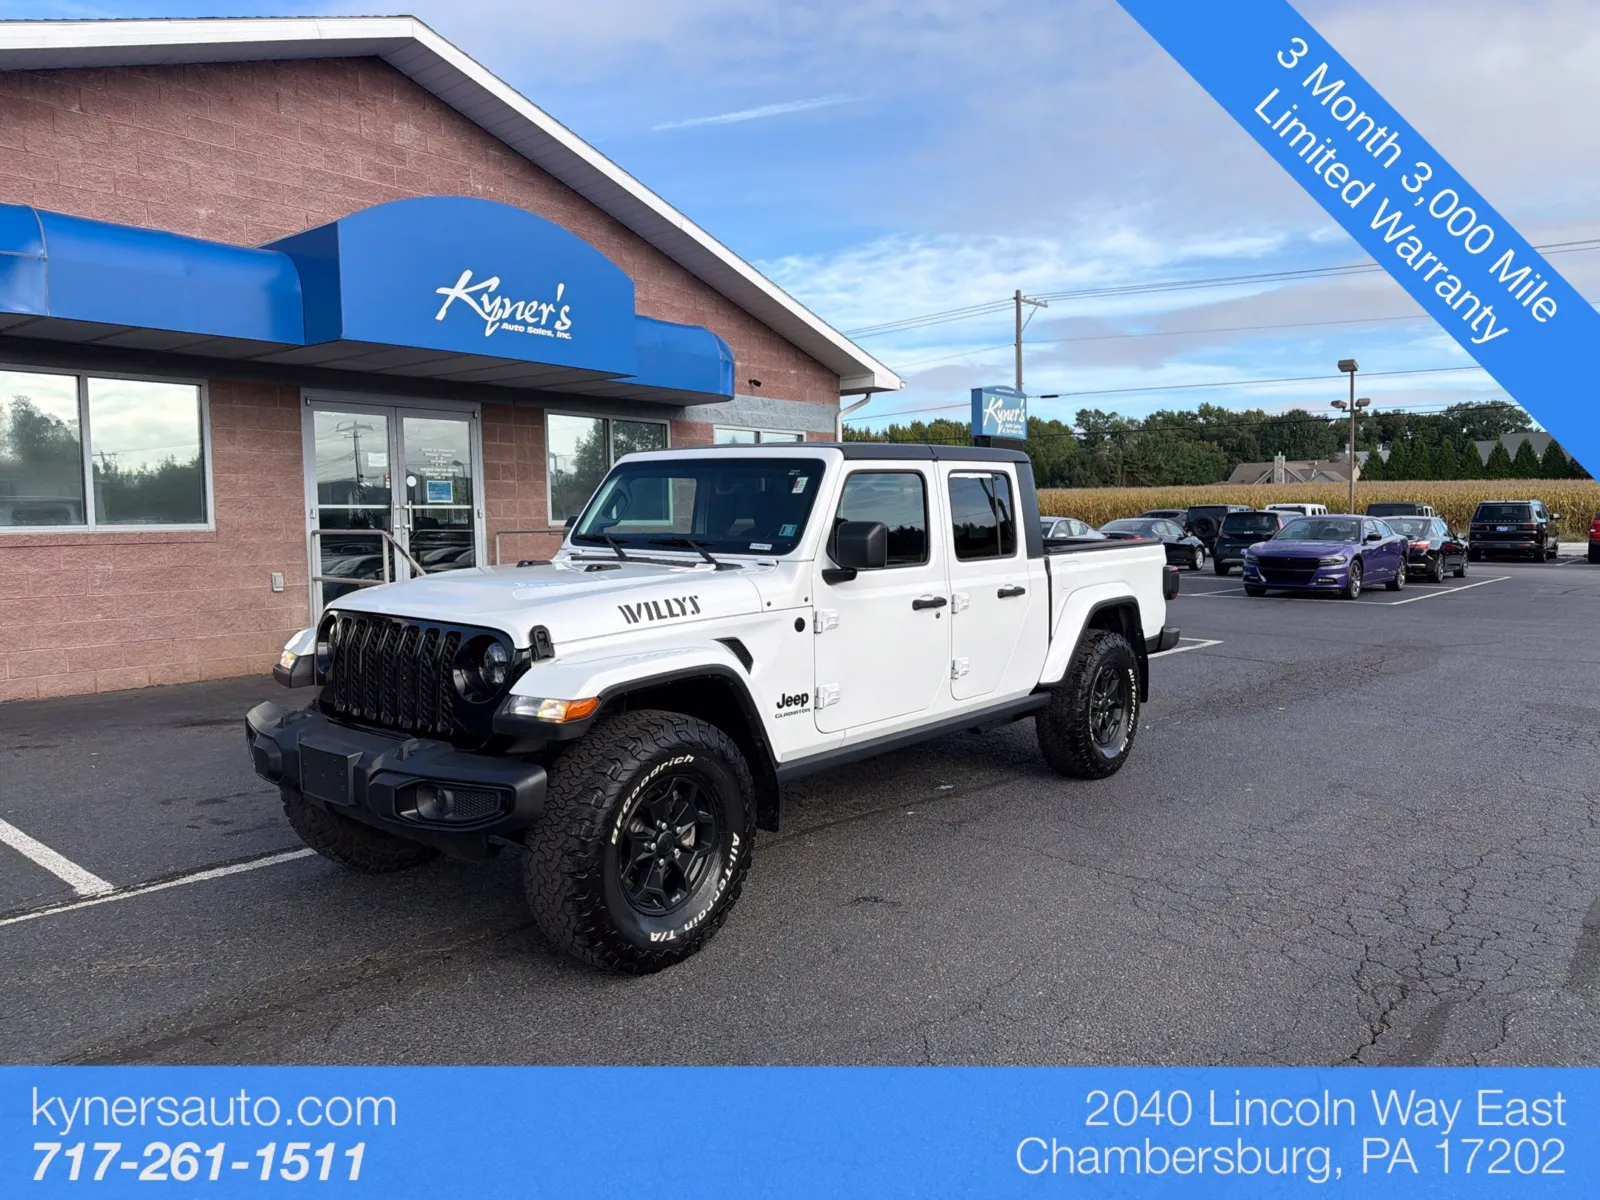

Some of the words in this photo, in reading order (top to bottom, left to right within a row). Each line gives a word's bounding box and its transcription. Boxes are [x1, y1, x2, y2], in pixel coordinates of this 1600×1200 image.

[435, 269, 572, 337] Kyner's
[501, 322, 525, 333] Auto
[526, 326, 554, 338] Sales,
[556, 330, 572, 340] Inc.
[983, 397, 1025, 435] Kyner's
[617, 595, 701, 624] WILLYS
[774, 707, 811, 719] GLADIATOR
[776, 692, 809, 710] Jeep
[610, 753, 695, 845] BFGoodrich
[684, 832, 741, 932] All-Terrain
[650, 929, 677, 942] T/A
